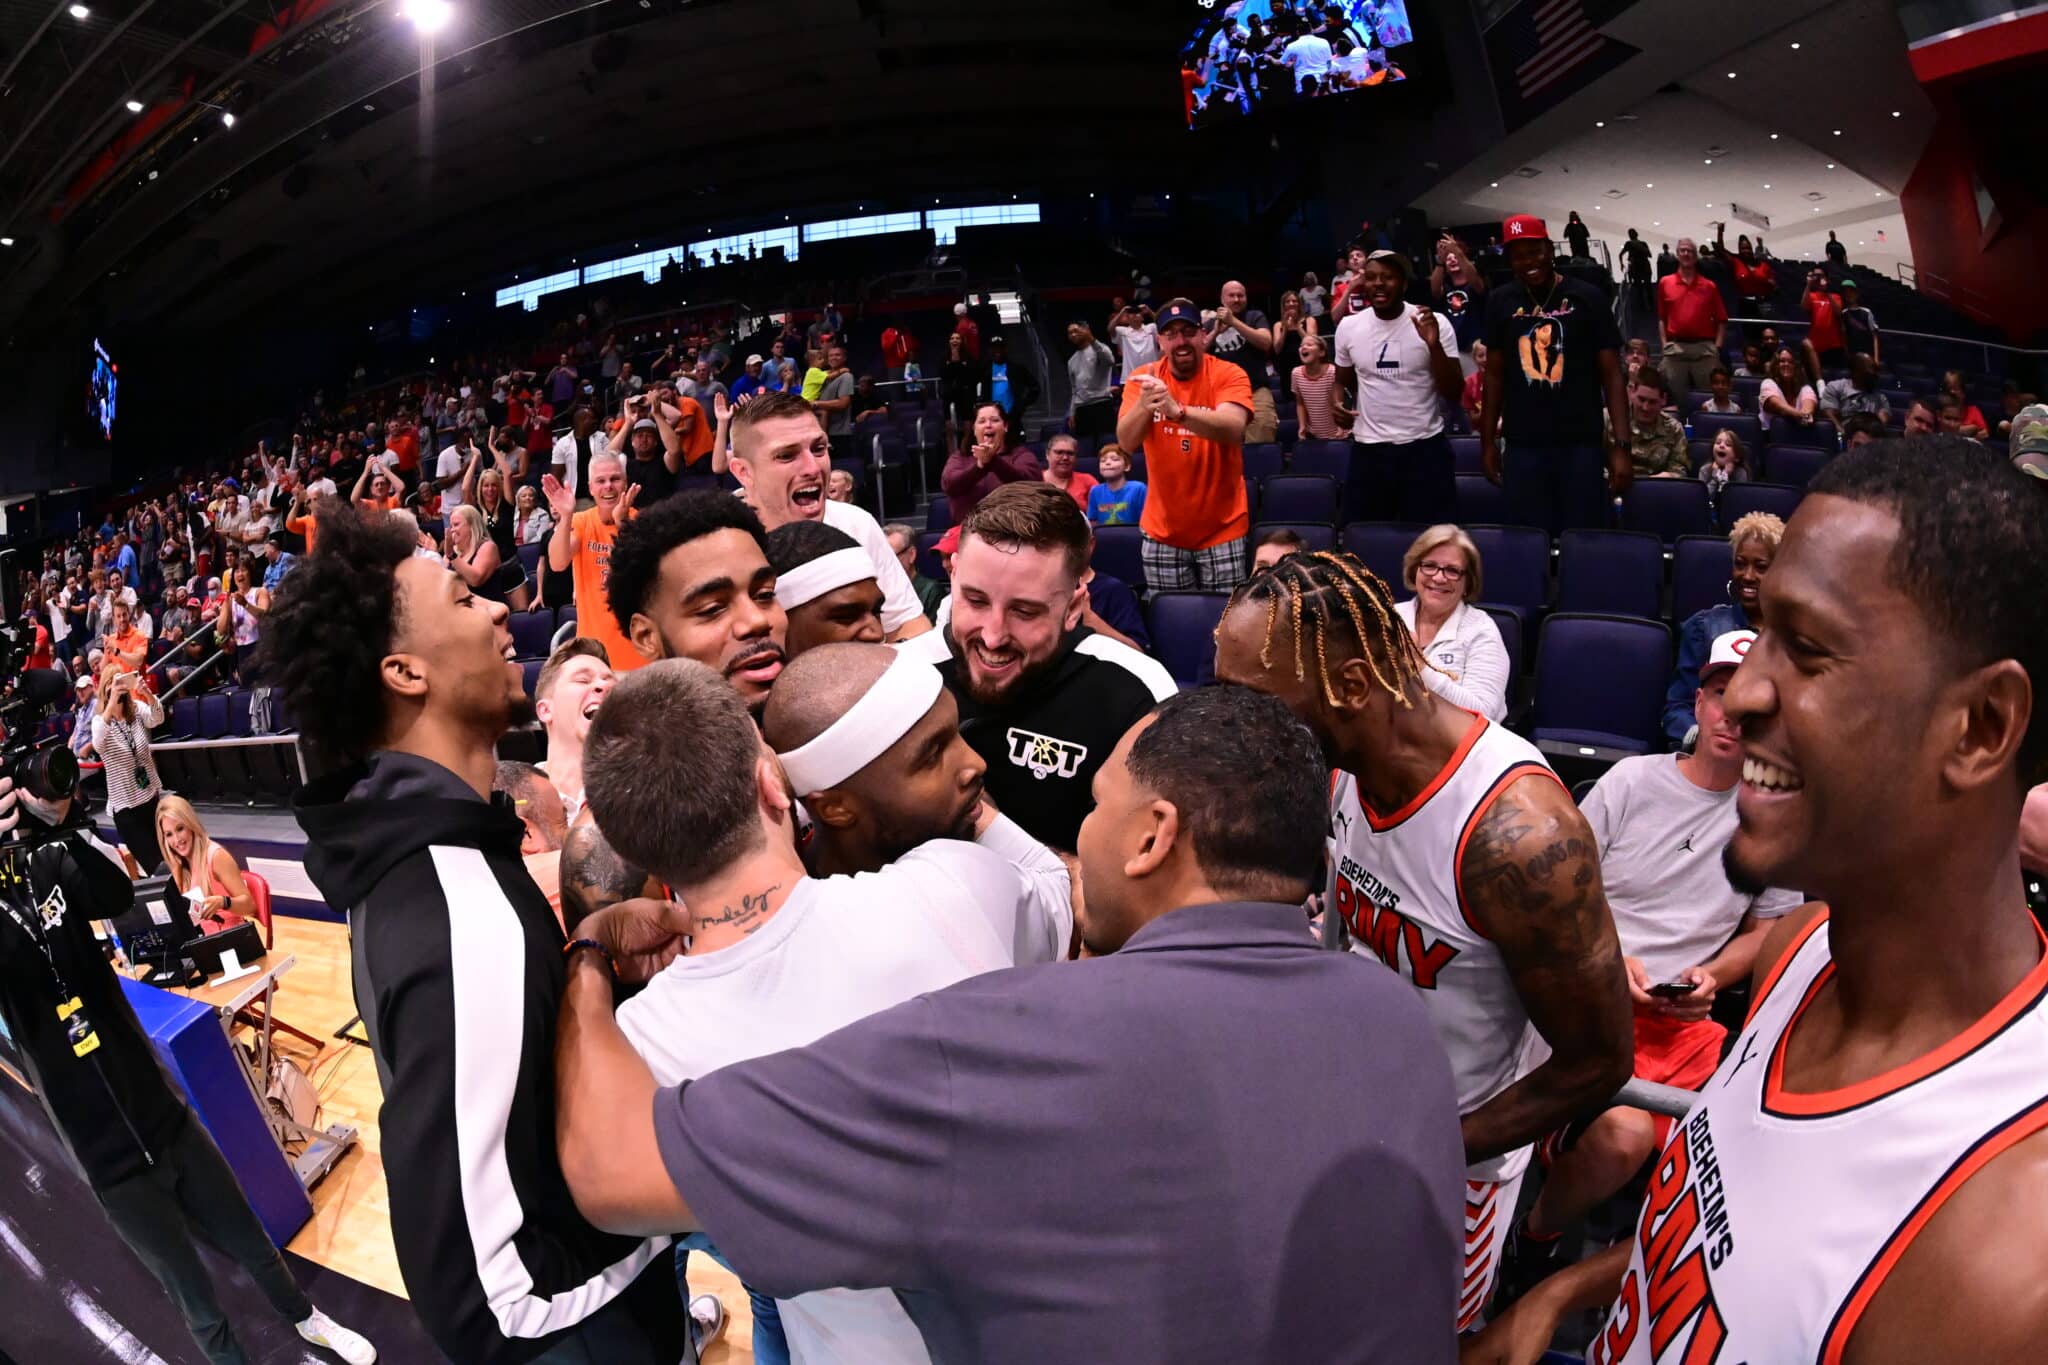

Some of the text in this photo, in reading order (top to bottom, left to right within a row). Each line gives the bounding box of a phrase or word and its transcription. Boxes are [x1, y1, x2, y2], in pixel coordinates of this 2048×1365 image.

[1335, 871, 1462, 990] RMY
[1339, 855, 1401, 910] BOEHEIM'S
[1639, 1122, 1729, 1365] RM
[1689, 1106, 1734, 1271] BOEHEIM'S
